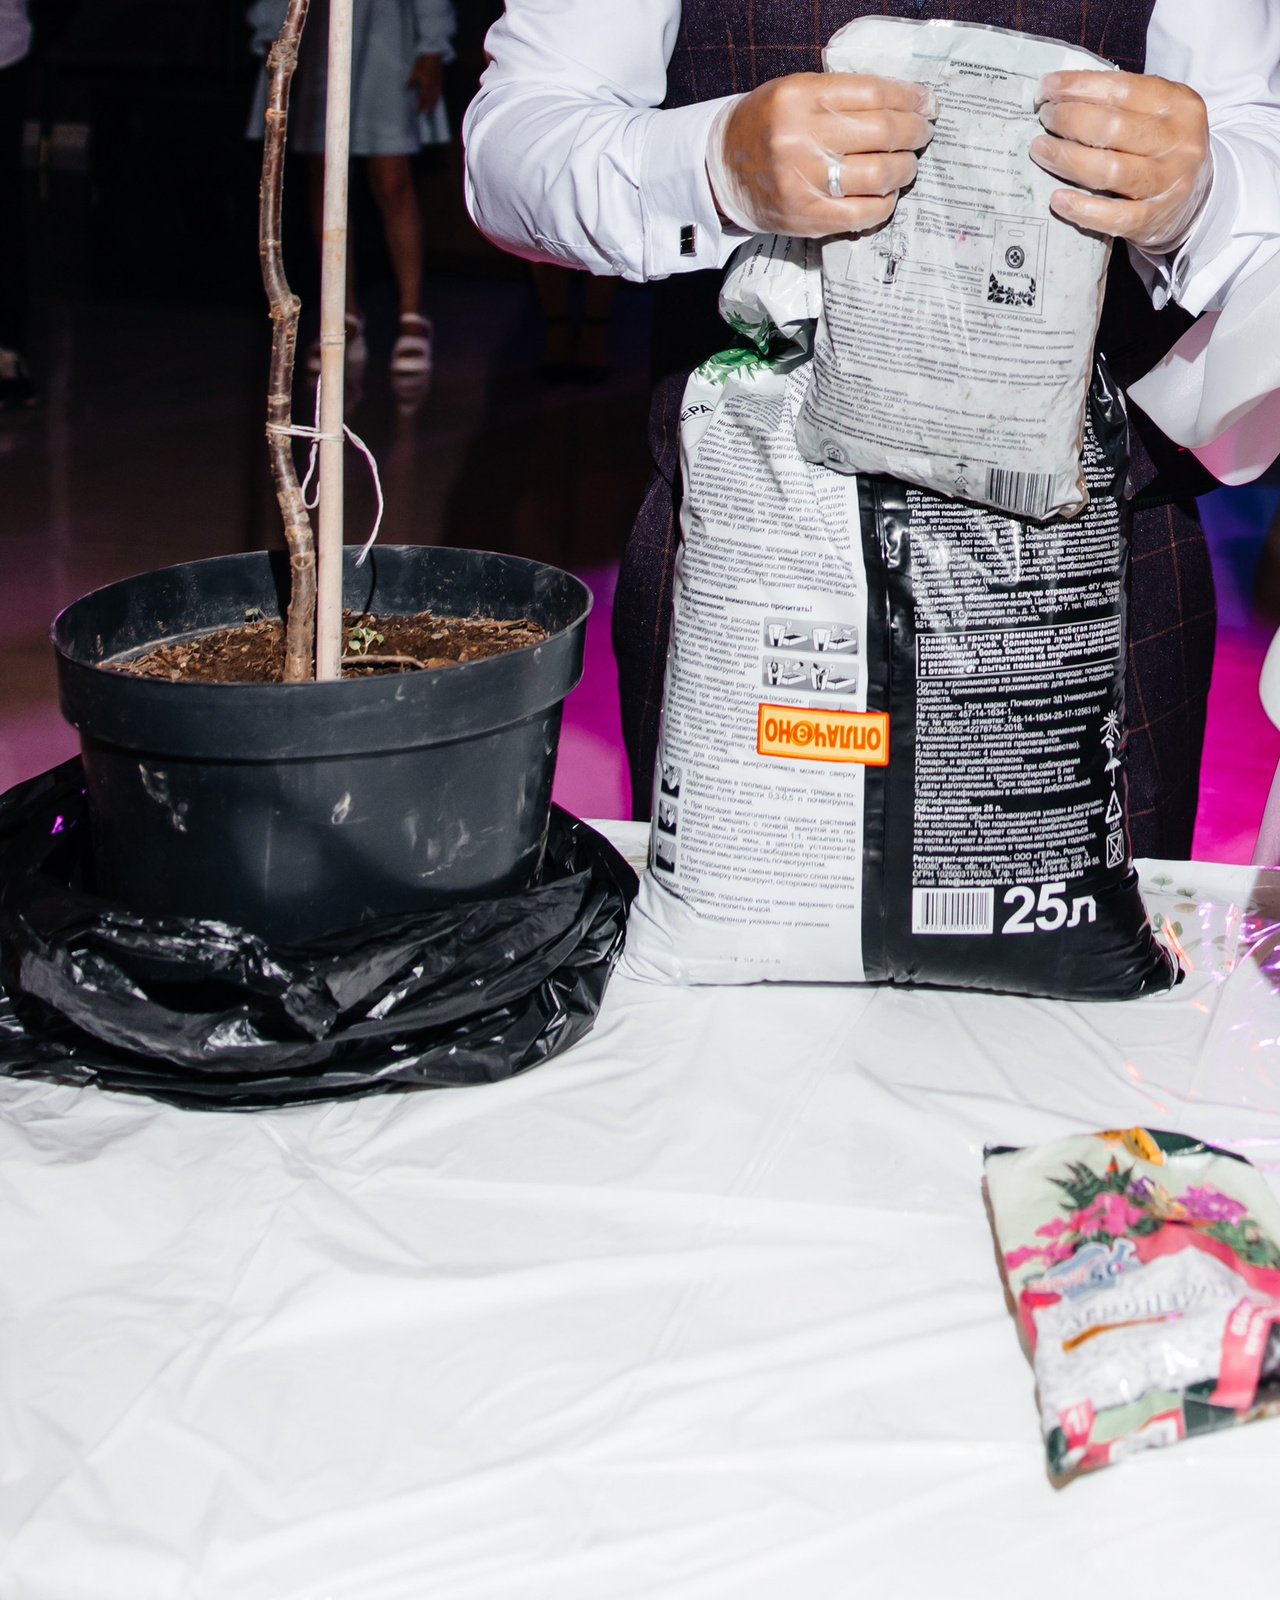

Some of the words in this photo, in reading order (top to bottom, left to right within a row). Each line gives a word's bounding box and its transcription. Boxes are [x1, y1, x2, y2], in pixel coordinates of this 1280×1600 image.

[681, 404, 714, 421] ЕРА
[920, 635, 957, 646] Хранить
[966, 633, 1001, 643] крытом
[1003, 629, 1056, 640] помещении,
[1058, 623, 1087, 634] избегая
[920, 643, 968, 651] солнечных
[970, 639, 999, 650] лучей.
[1002, 635, 1051, 646] Солнечные
[1053, 634, 1072, 644] лучи
[920, 649, 976, 660] способствуют
[978, 647, 1002, 656] более
[1004, 643, 1044, 656] быстрому
[1046, 640, 1086, 652] выгоранию
[927, 658, 980, 668] разложению
[980, 654, 1034, 663] полиэтилена
[1046, 648, 1082, 660] открытом
[977, 663, 1010, 673] крытых
[1012, 658, 1063, 670] помещений.
